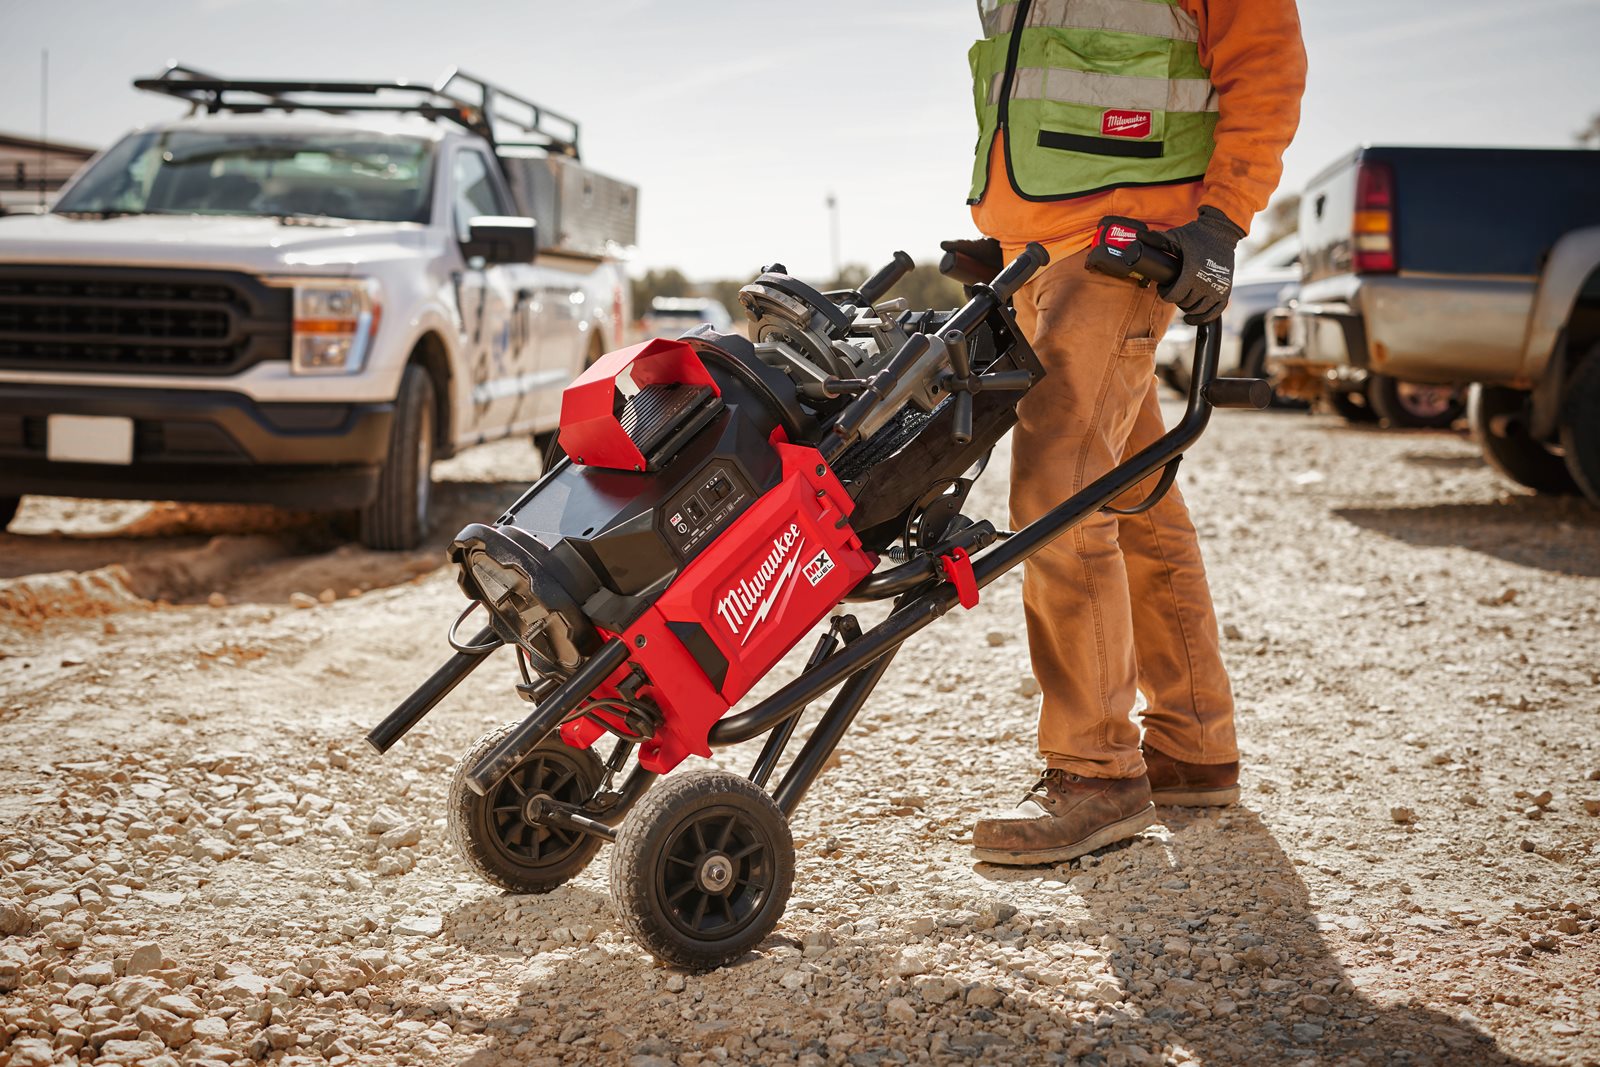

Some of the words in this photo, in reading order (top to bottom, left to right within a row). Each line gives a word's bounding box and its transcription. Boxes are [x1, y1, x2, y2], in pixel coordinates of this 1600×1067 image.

[1106, 115, 1147, 128] Milwaukee
[1110, 226, 1137, 238] Milwau
[805, 552, 829, 579] MX
[811, 563, 834, 584] FUEL
[717, 523, 801, 634] Milwaukee
